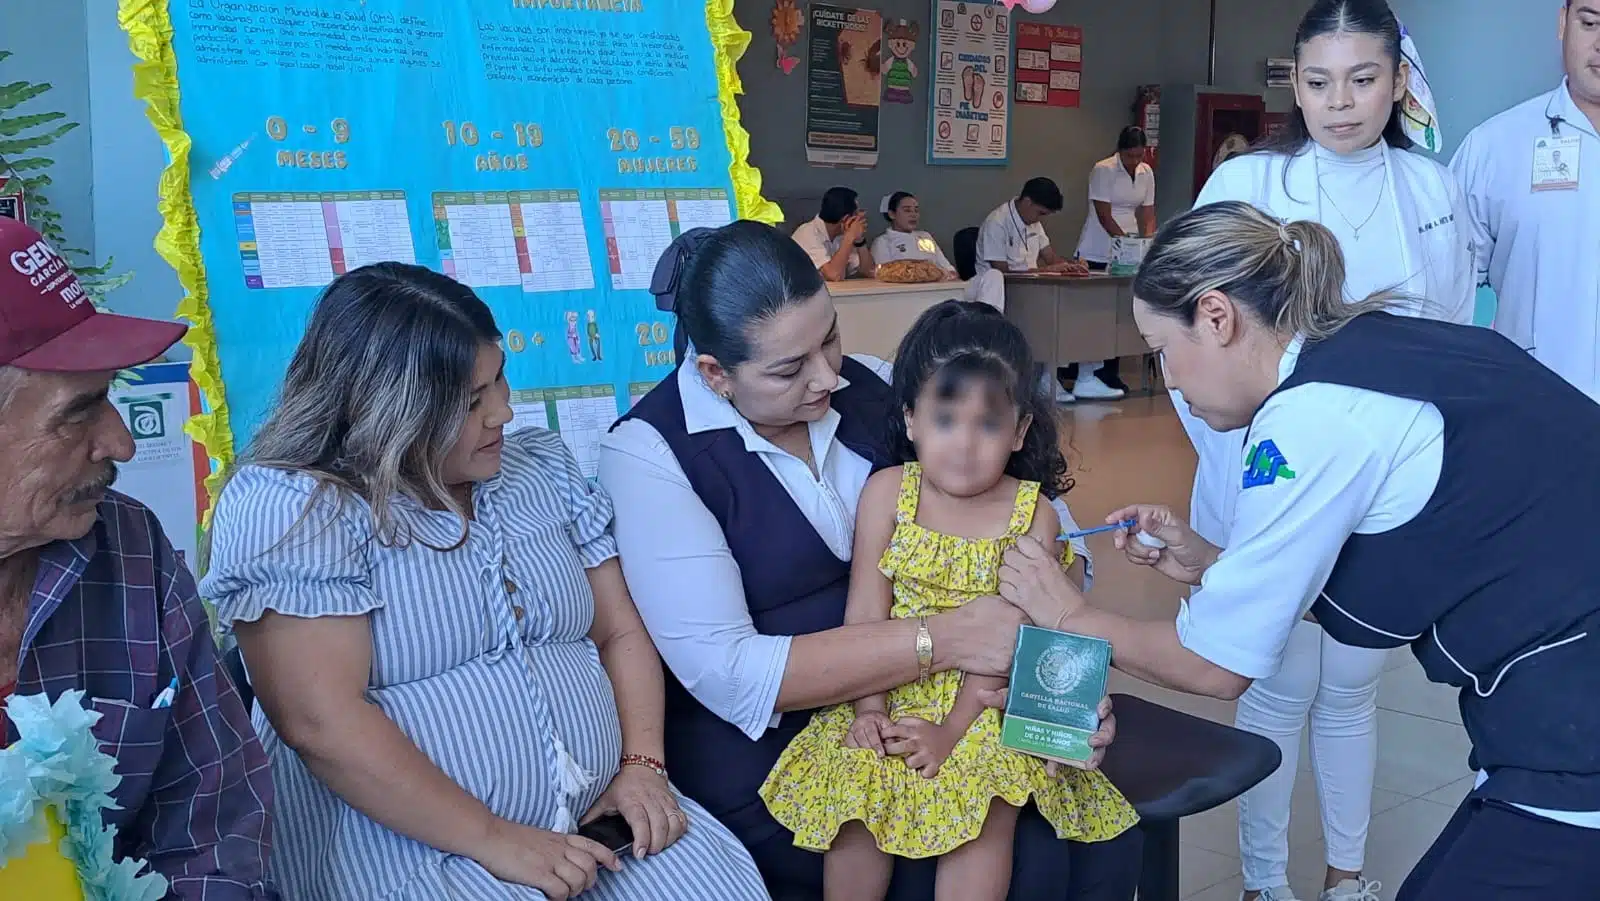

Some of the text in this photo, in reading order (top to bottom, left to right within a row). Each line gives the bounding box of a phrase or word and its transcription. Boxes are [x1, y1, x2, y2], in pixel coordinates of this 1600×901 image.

[284, 6, 319, 17] Mundial
[344, 8, 366, 21] Salud
[415, 29, 444, 39] generar
[477, 19, 495, 31] Las
[265, 115, 288, 141] 0
[331, 118, 350, 144] 9
[441, 120, 479, 147] 10
[607, 127, 639, 152] 20
[276, 150, 348, 169] MESES
[618, 156, 698, 174] MUJERES
[636, 321, 669, 346] 20
[1021, 691, 1088, 710] CARTILLA NACIONAL
[1047, 704, 1070, 714] SALUD
[1024, 732, 1034, 740] DE
[1051, 730, 1073, 739] NIÑOS
